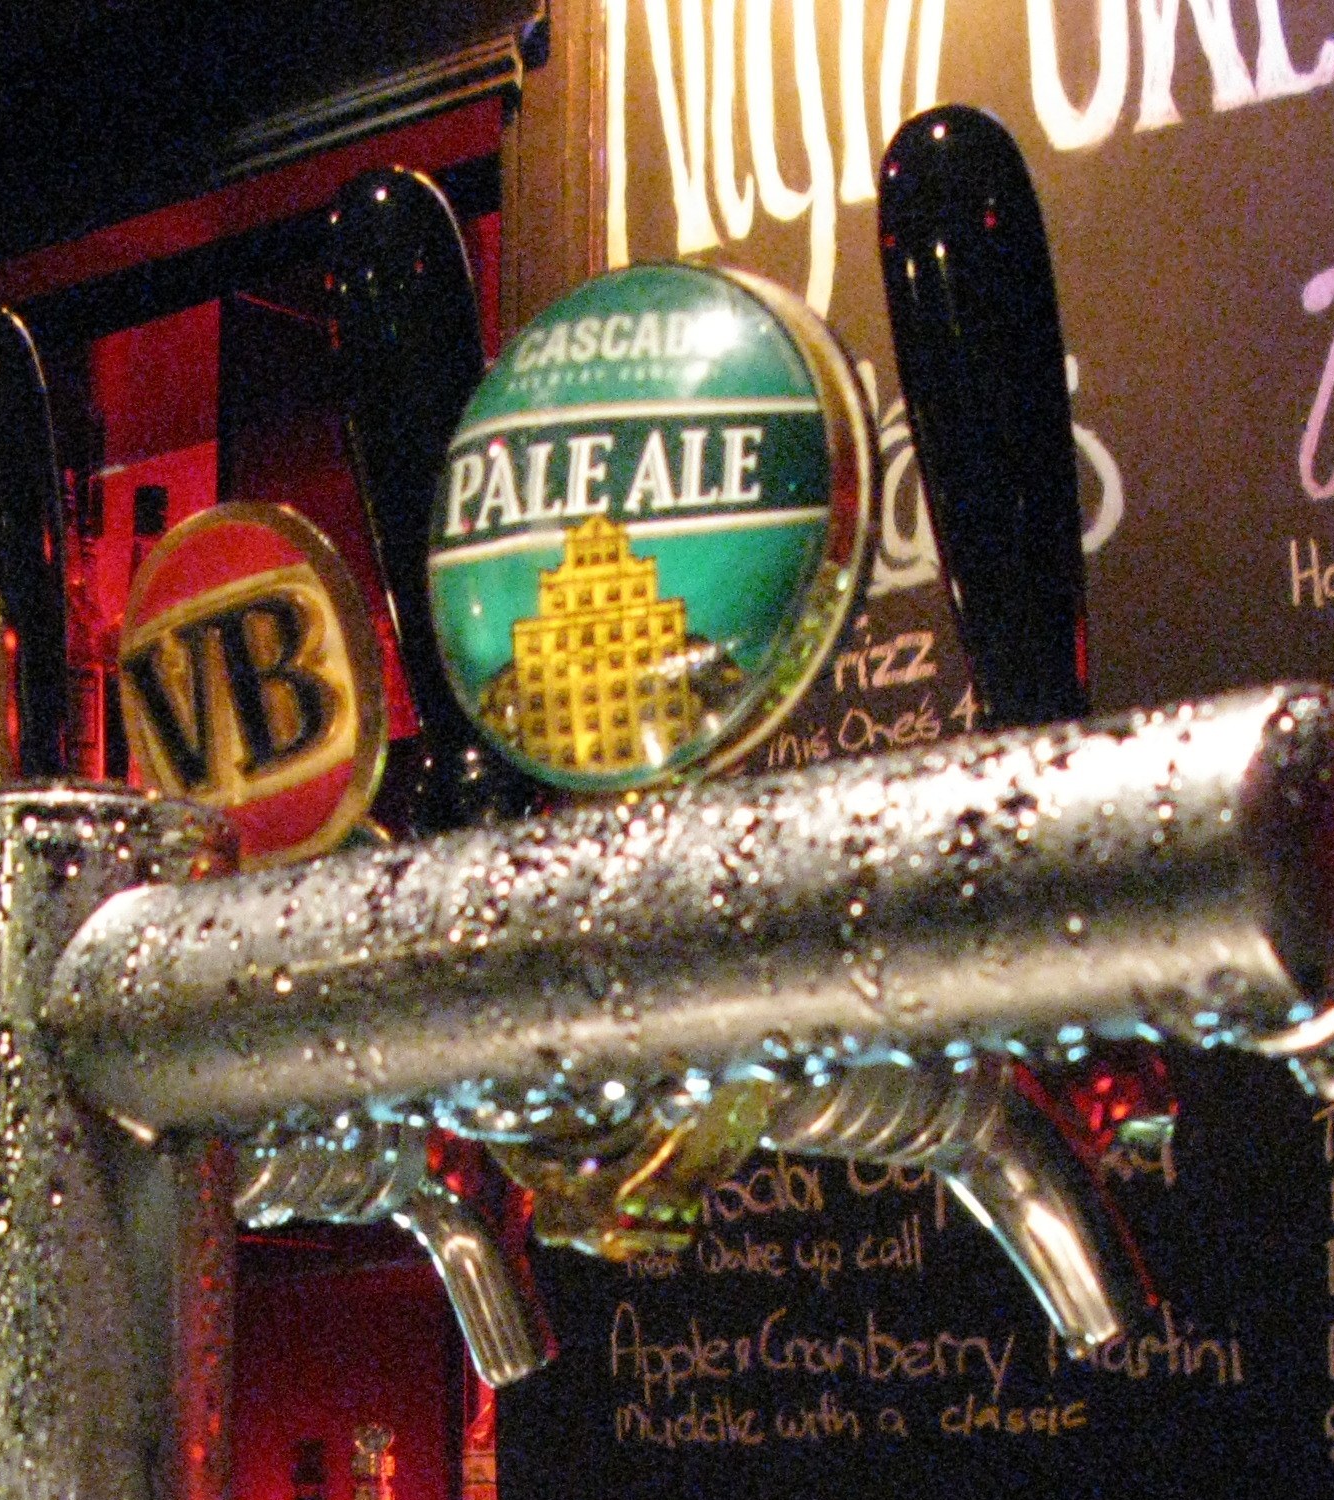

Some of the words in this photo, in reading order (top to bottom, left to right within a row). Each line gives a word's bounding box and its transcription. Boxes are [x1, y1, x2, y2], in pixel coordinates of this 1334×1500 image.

[515, 310, 727, 373] CASCAD
[443, 432, 614, 538] PALE
[623, 426, 763, 513] ALE
[123, 597, 335, 790] VB
[797, 1238, 843, 1291] up
[857, 1214, 924, 1271] call
[611, 1301, 733, 1405] Apple
[760, 1306, 1017, 1402] Cranberry
[776, 1391, 860, 1441] with
[878, 1407, 909, 1437] a
